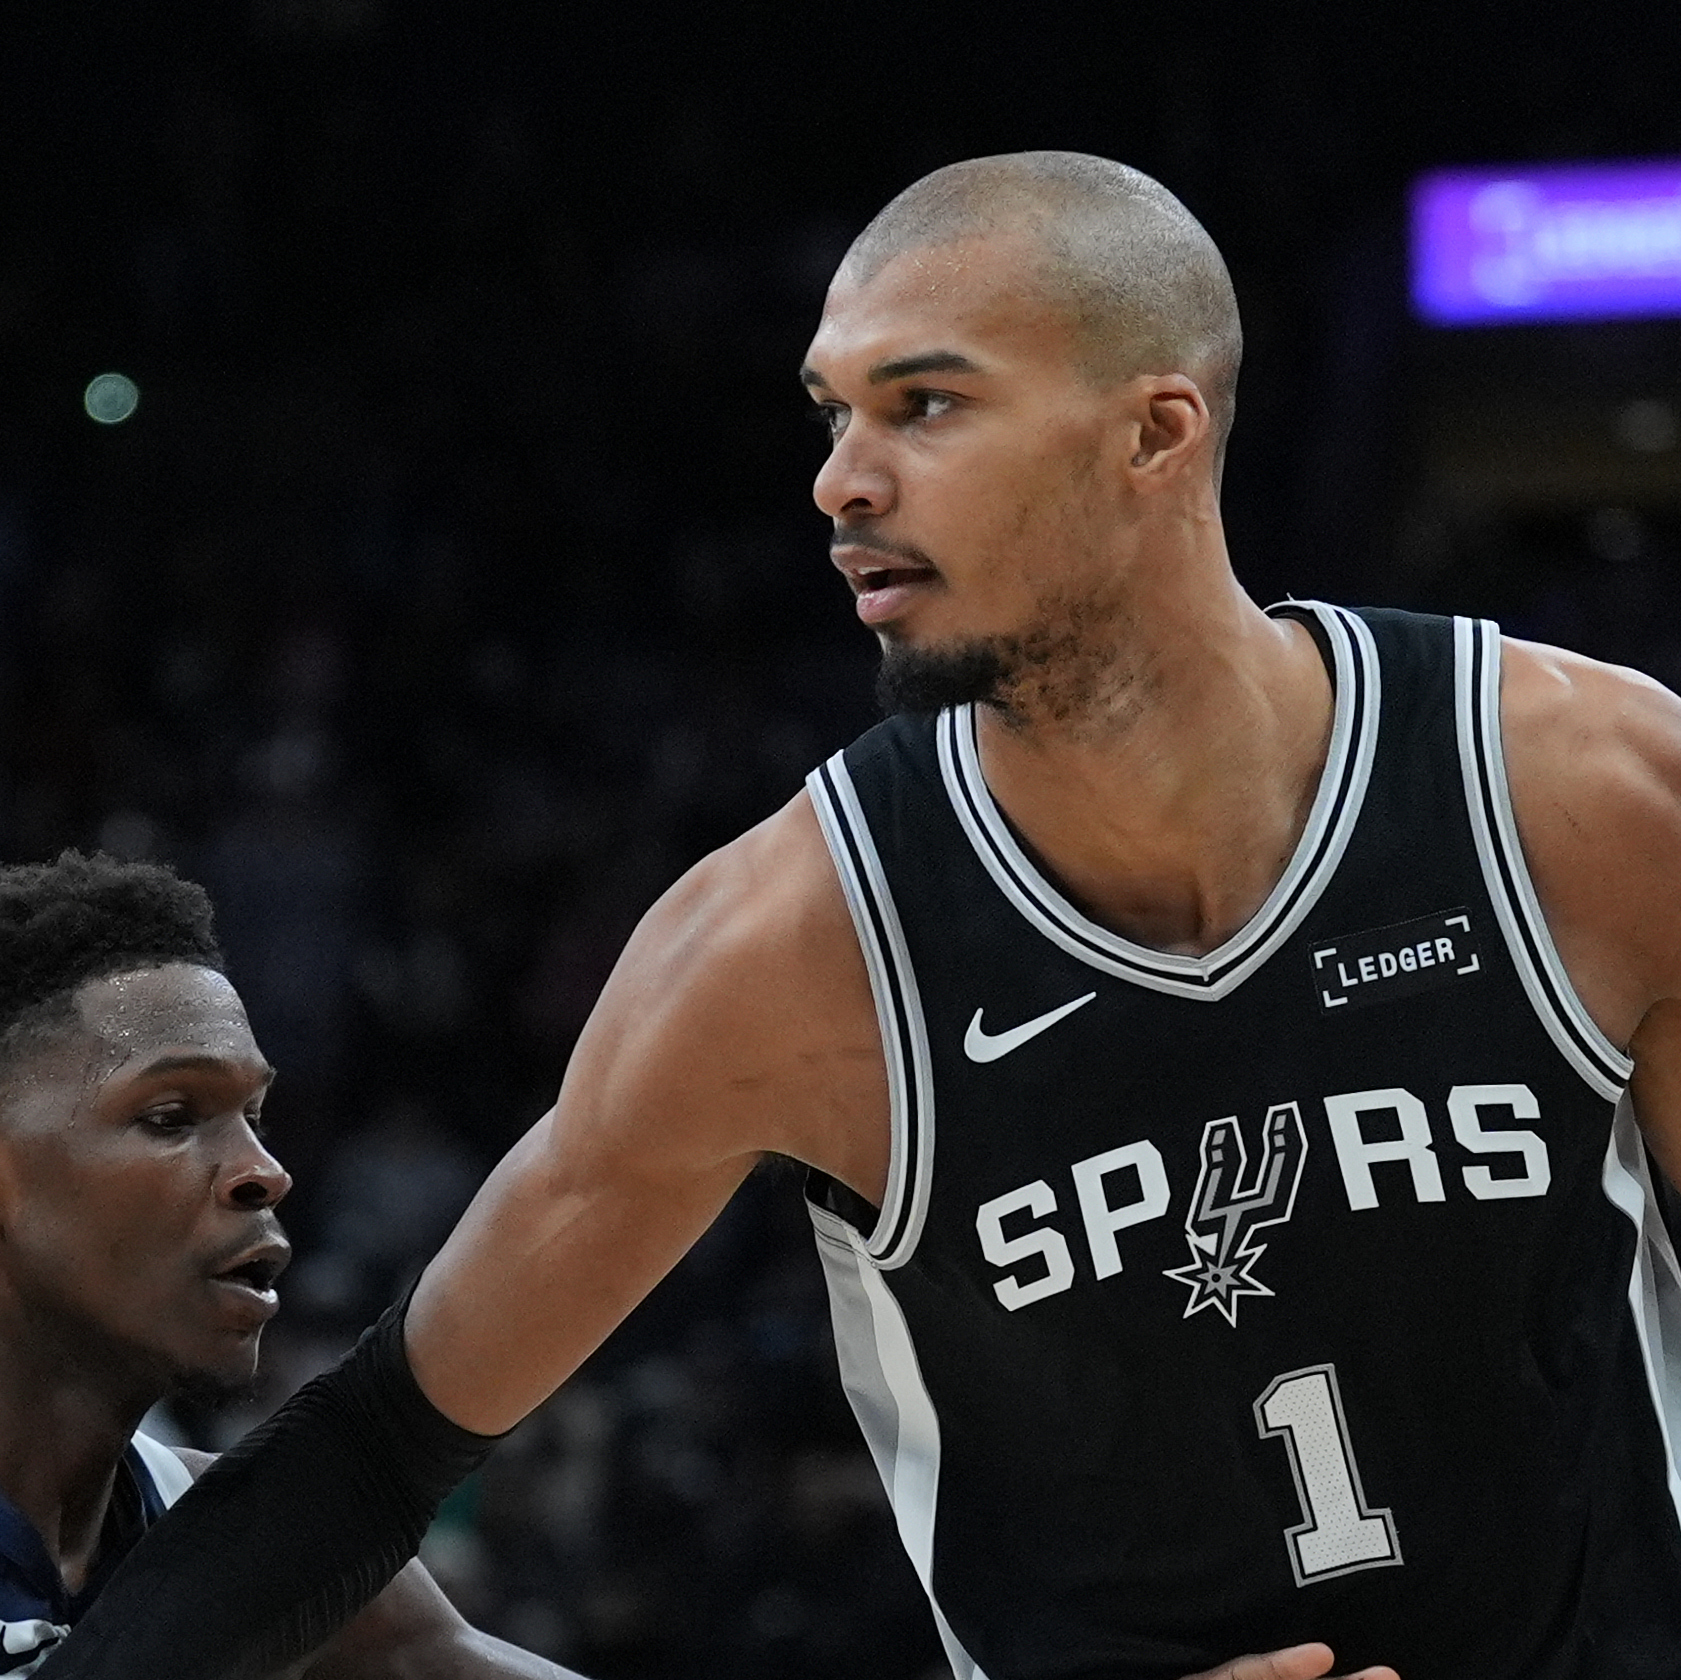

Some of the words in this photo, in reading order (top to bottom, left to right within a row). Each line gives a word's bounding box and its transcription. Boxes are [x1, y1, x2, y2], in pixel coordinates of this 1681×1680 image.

[1337, 937, 1456, 988] LEDGER
[974, 1083, 1553, 1329] SPURS
[1252, 1363, 1405, 1588] 1
